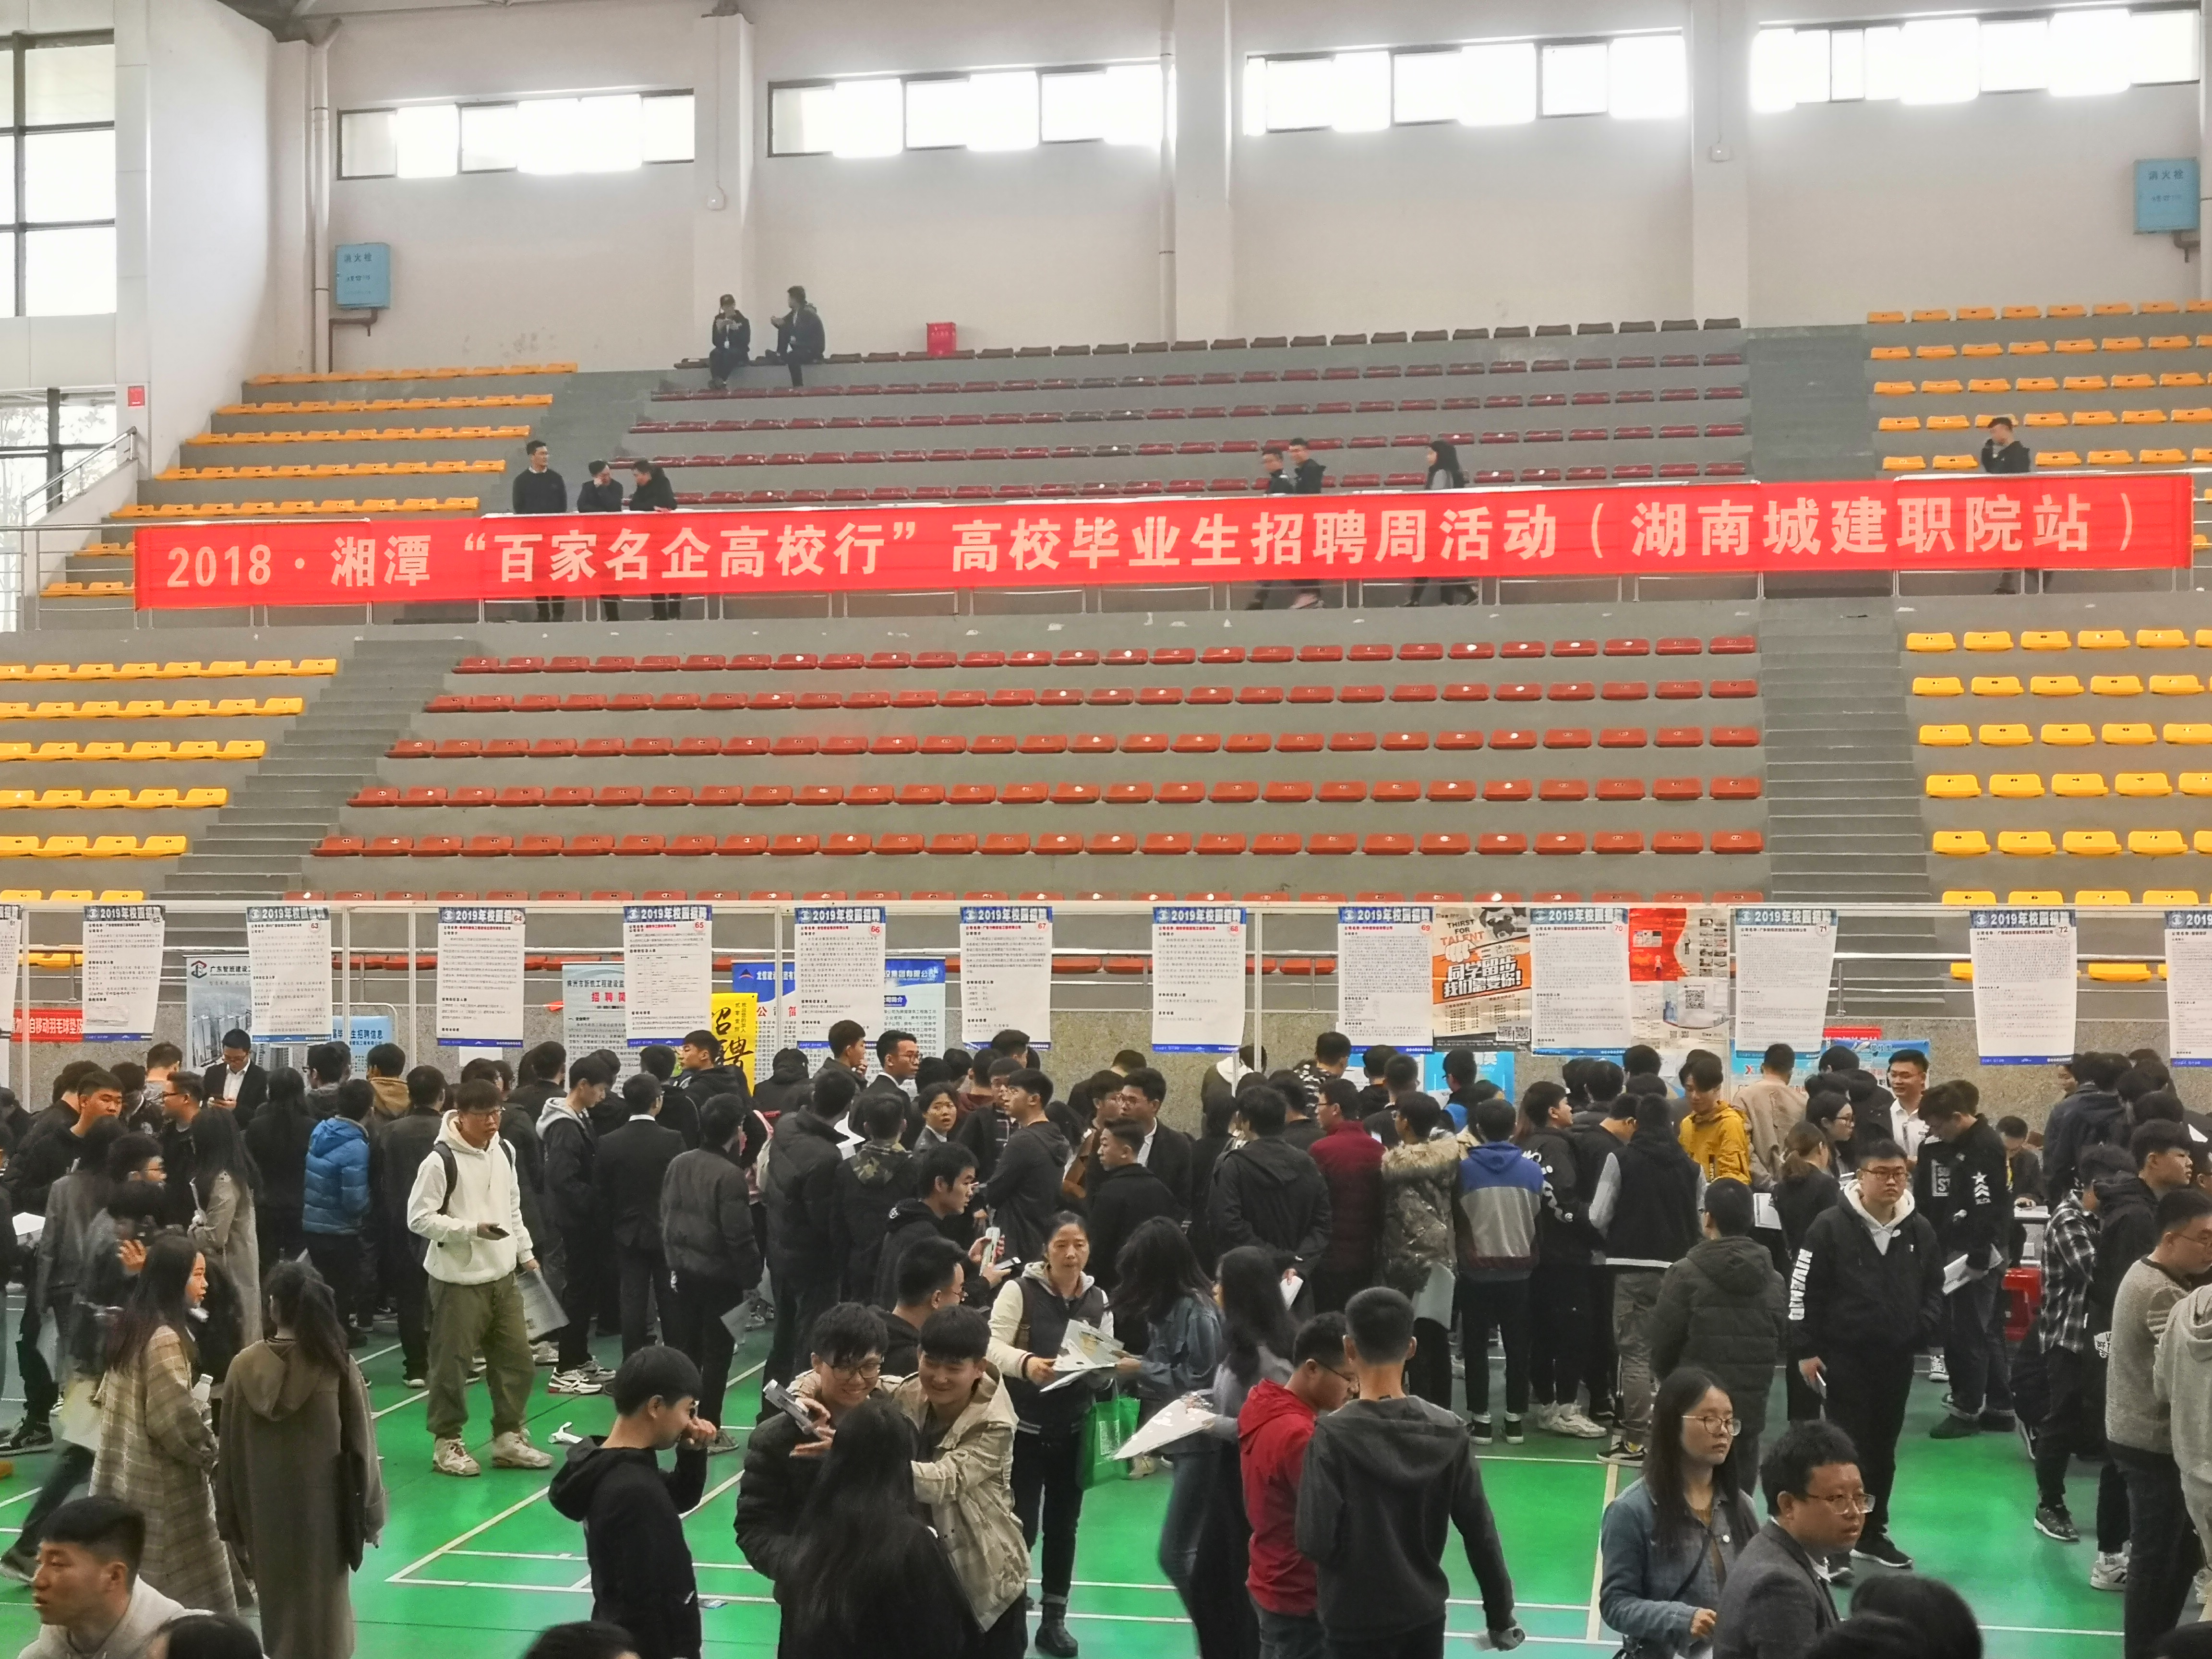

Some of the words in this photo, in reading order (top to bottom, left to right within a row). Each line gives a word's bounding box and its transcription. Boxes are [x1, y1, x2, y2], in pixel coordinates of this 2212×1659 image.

[455, 908, 520, 922] 2019年校园招
[641, 906, 707, 920] 2019年校园招聘
[813, 908, 880, 922] 2019年校园招聘
[1447, 919, 1475, 929] THIRST
[1440, 931, 1485, 946] TALENT
[1448, 954, 1517, 982] 同学留步
[1444, 970, 1522, 998] 我们需要你!
[333, 1029, 383, 1039] 届毕生招聘信息
